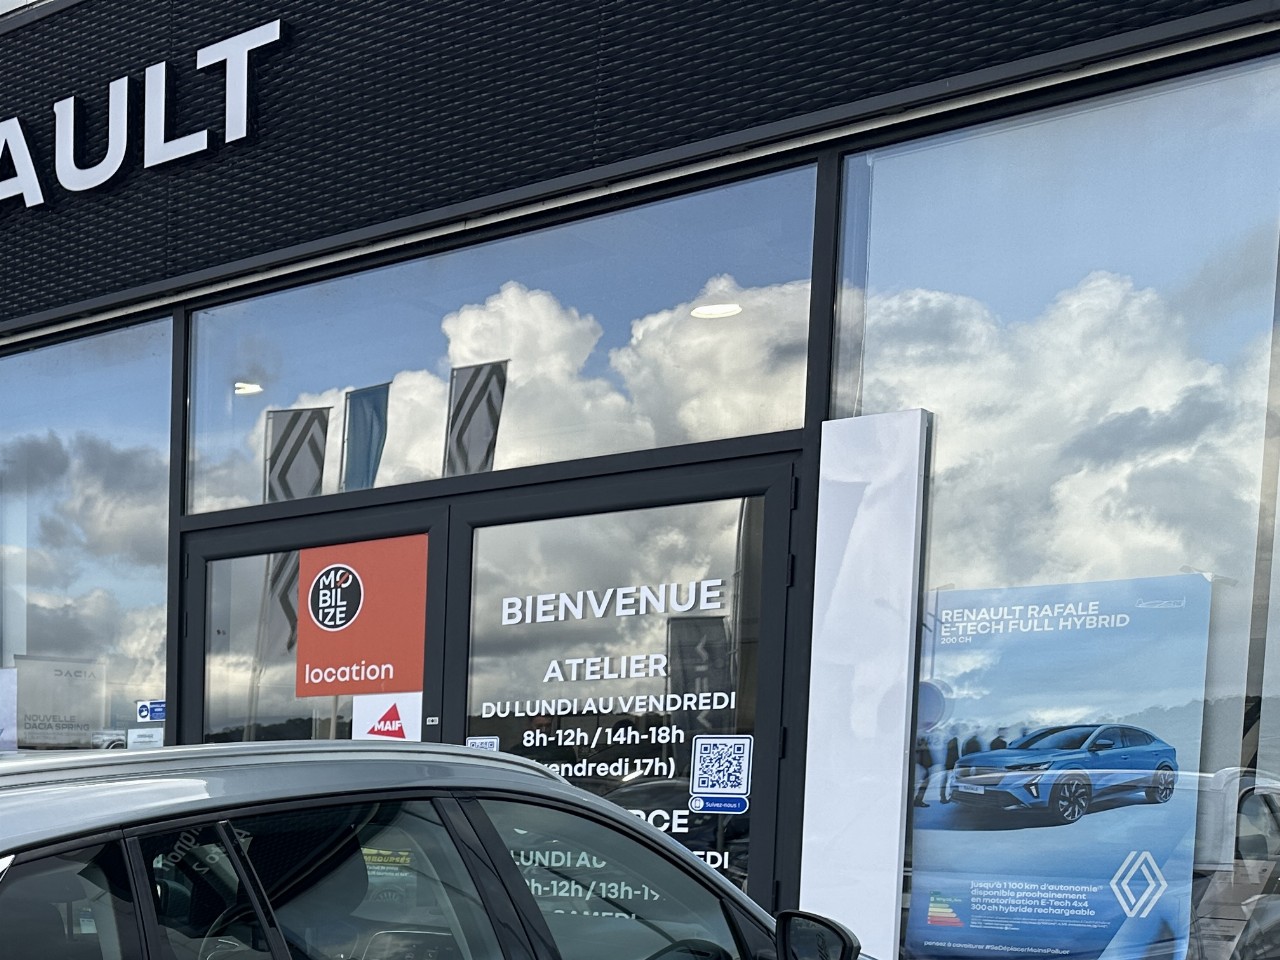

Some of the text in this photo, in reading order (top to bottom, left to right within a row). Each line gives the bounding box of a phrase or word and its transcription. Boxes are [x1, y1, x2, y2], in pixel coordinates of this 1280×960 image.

[501, 579, 722, 626] BIENVENUE
[941, 601, 1100, 622] RENAULT RAFALE
[941, 614, 1131, 636] E-TECH FULL HYBRID
[940, 636, 972, 645] 200 CH
[305, 660, 394, 684] location
[542, 653, 668, 683] ATELIER
[481, 691, 737, 719] DU LUNDI AU VENDREDI
[24, 714, 77, 723] NOUVELLE
[374, 720, 403, 732] MAIF
[55, 723, 90, 732] SPRING
[522, 728, 589, 748] 8h-12h
[524, 879, 583, 898] h-12h
[970, 888, 1087, 900] disponible prochainement
[1024, 882, 1039, 890] km
[970, 903, 986, 911] 300
[998, 905, 1033, 914] hybride
[1033, 906, 1096, 916] rechargeable
[982, 896, 1039, 906] motorisation
[1040, 899, 1071, 907] E-Tech
[1072, 900, 1088, 908] 4x4
